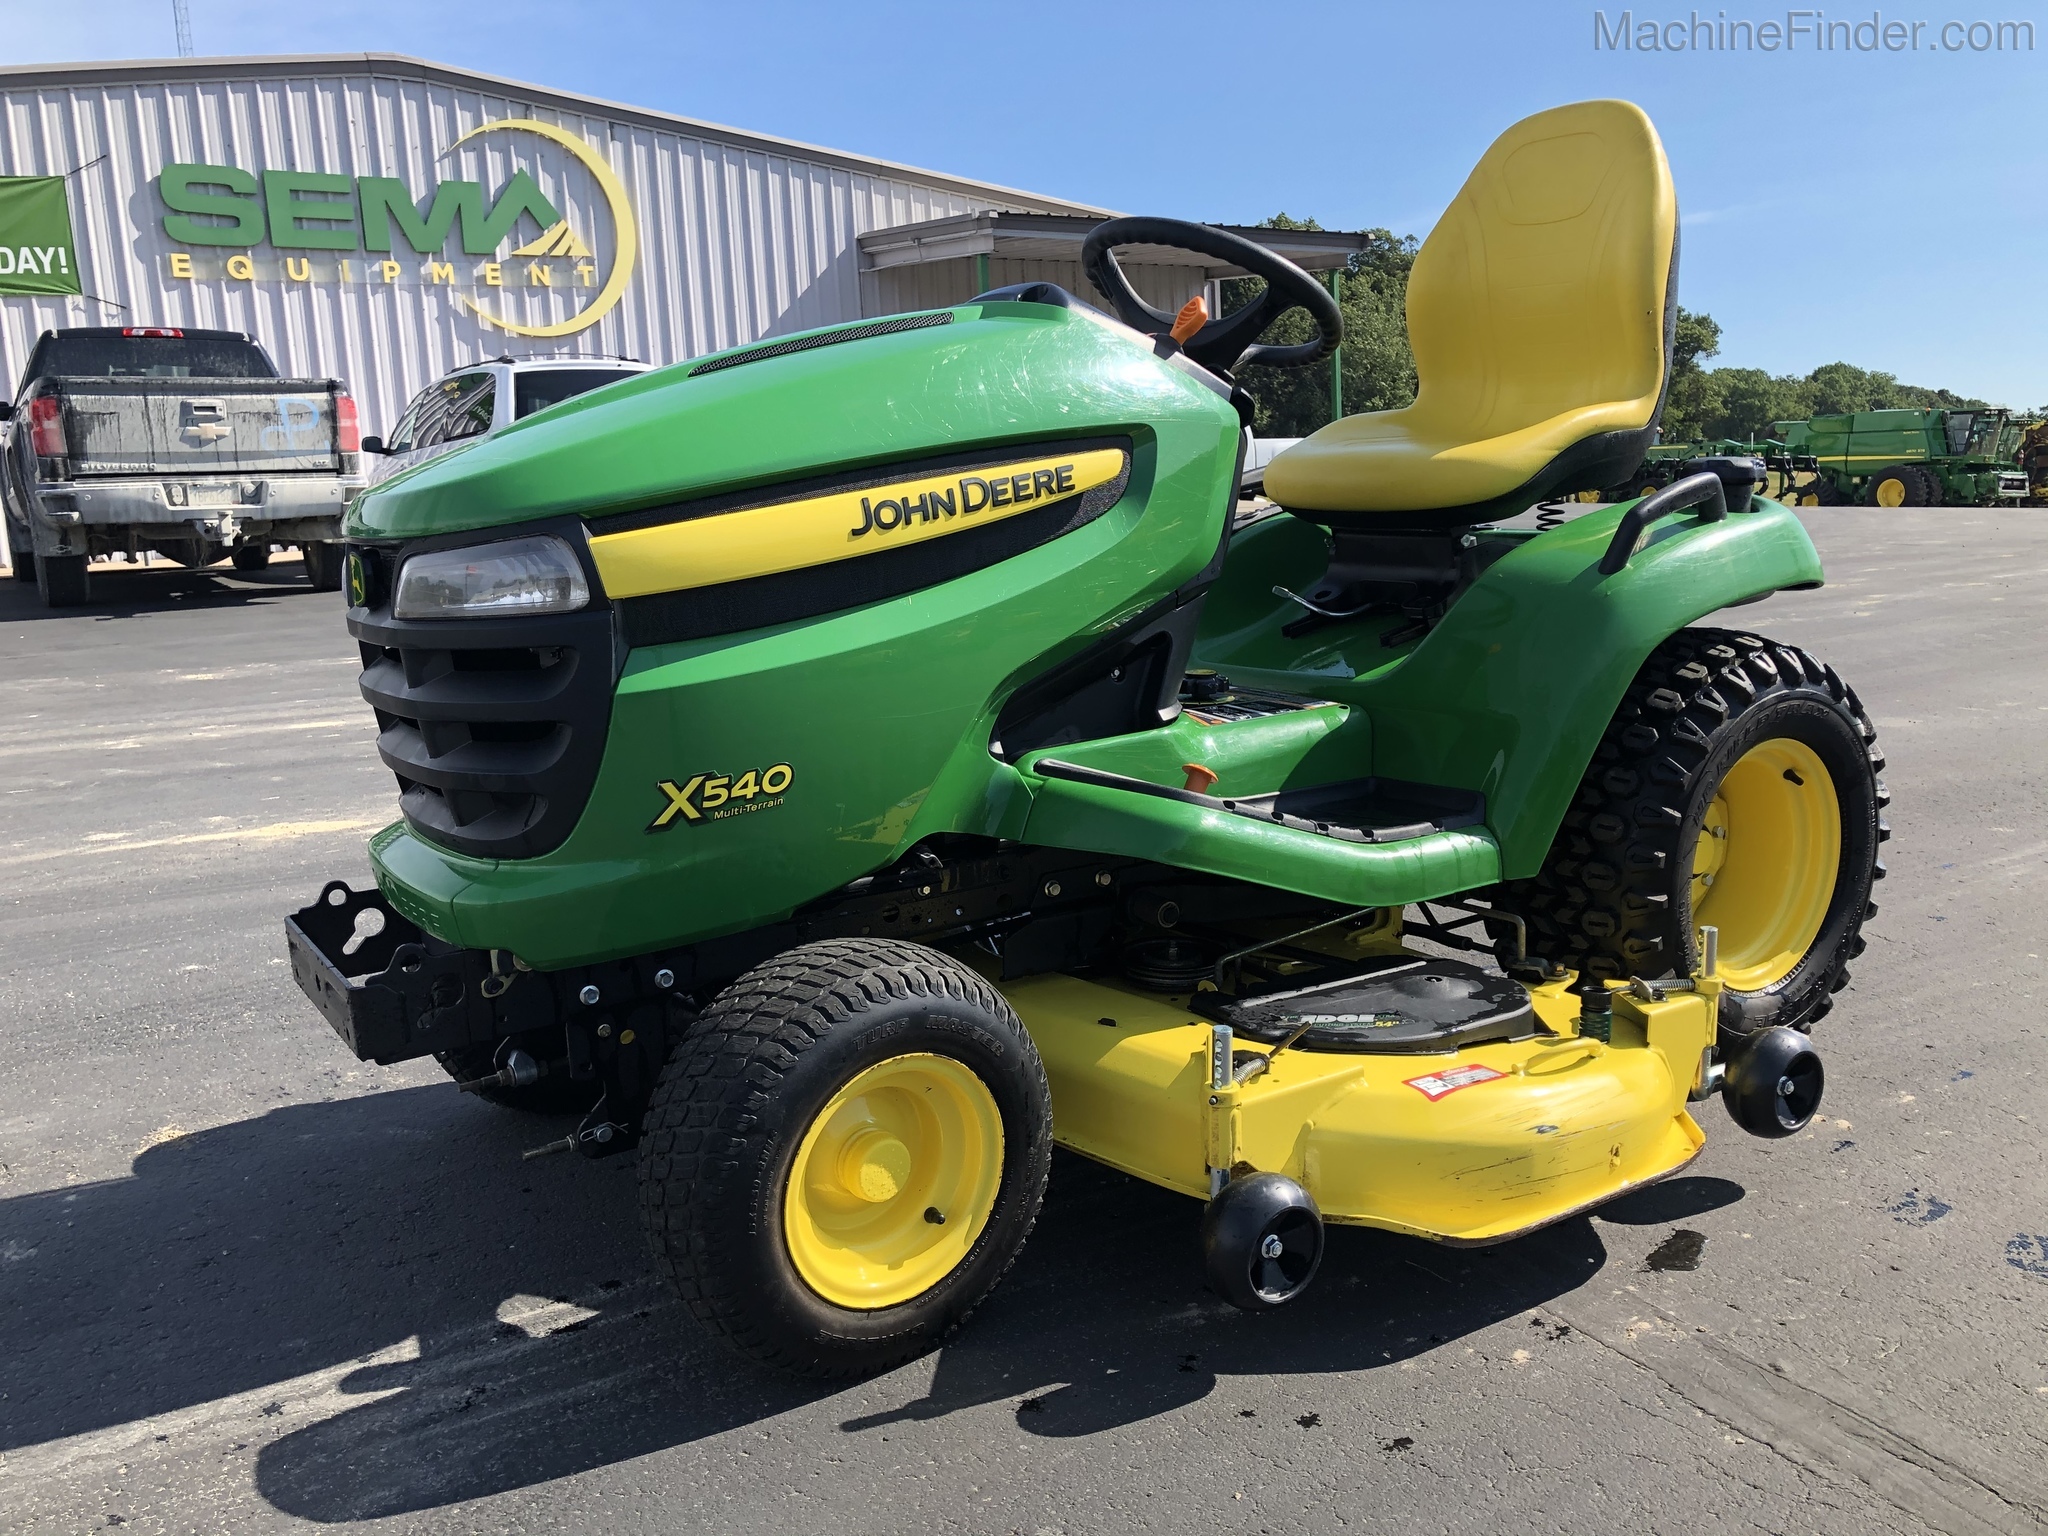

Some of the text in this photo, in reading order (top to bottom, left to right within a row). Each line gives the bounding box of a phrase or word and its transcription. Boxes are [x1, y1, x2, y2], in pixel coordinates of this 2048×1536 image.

[160, 163, 590, 256] SEMA
[0, 246, 69, 275] DAY!
[170, 253, 594, 287] EQUIPMENT
[850, 464, 1076, 537] JOHN DEERE
[651, 763, 793, 828] X540
[713, 797, 784, 820] Multi-Terrain
[851, 1014, 1006, 1058] TURF MASTER
